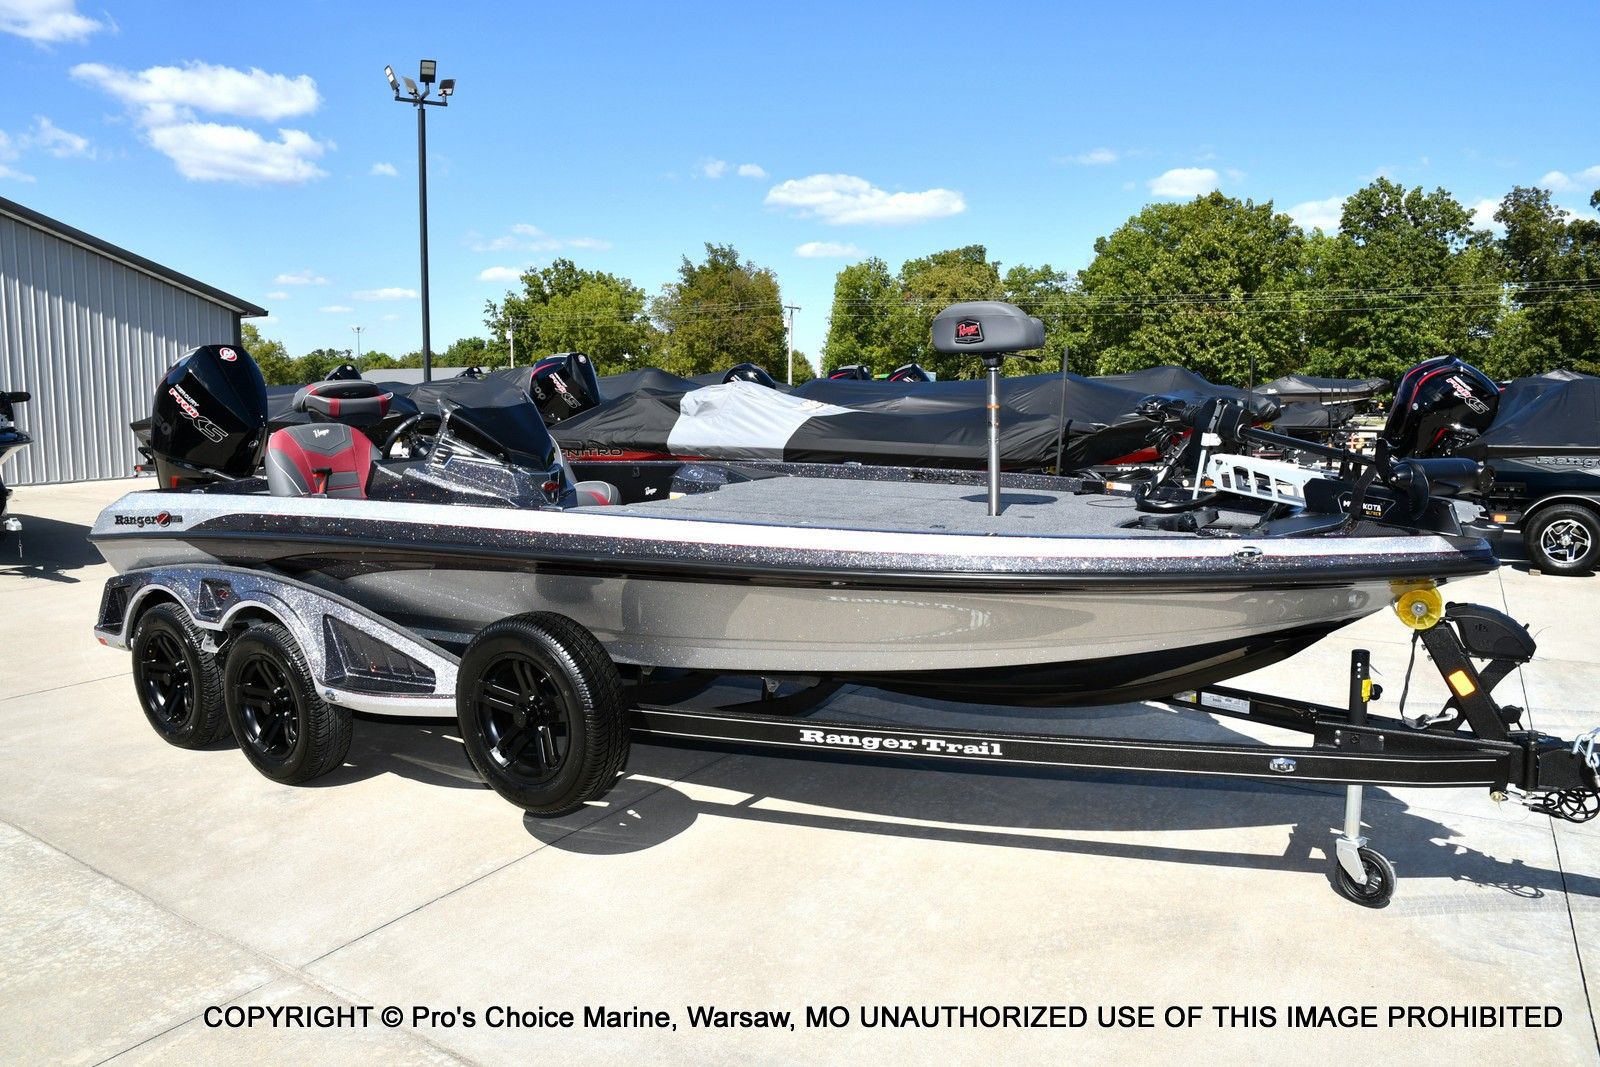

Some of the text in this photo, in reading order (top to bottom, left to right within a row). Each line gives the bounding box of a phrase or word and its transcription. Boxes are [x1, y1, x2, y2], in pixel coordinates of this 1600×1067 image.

[174, 384, 200, 407] MERCURY
[168, 388, 229, 443] PRO XS
[1362, 502, 1382, 512] KOTA
[114, 514, 157, 528] Ranger
[799, 729, 1003, 756] Ranger Trail
